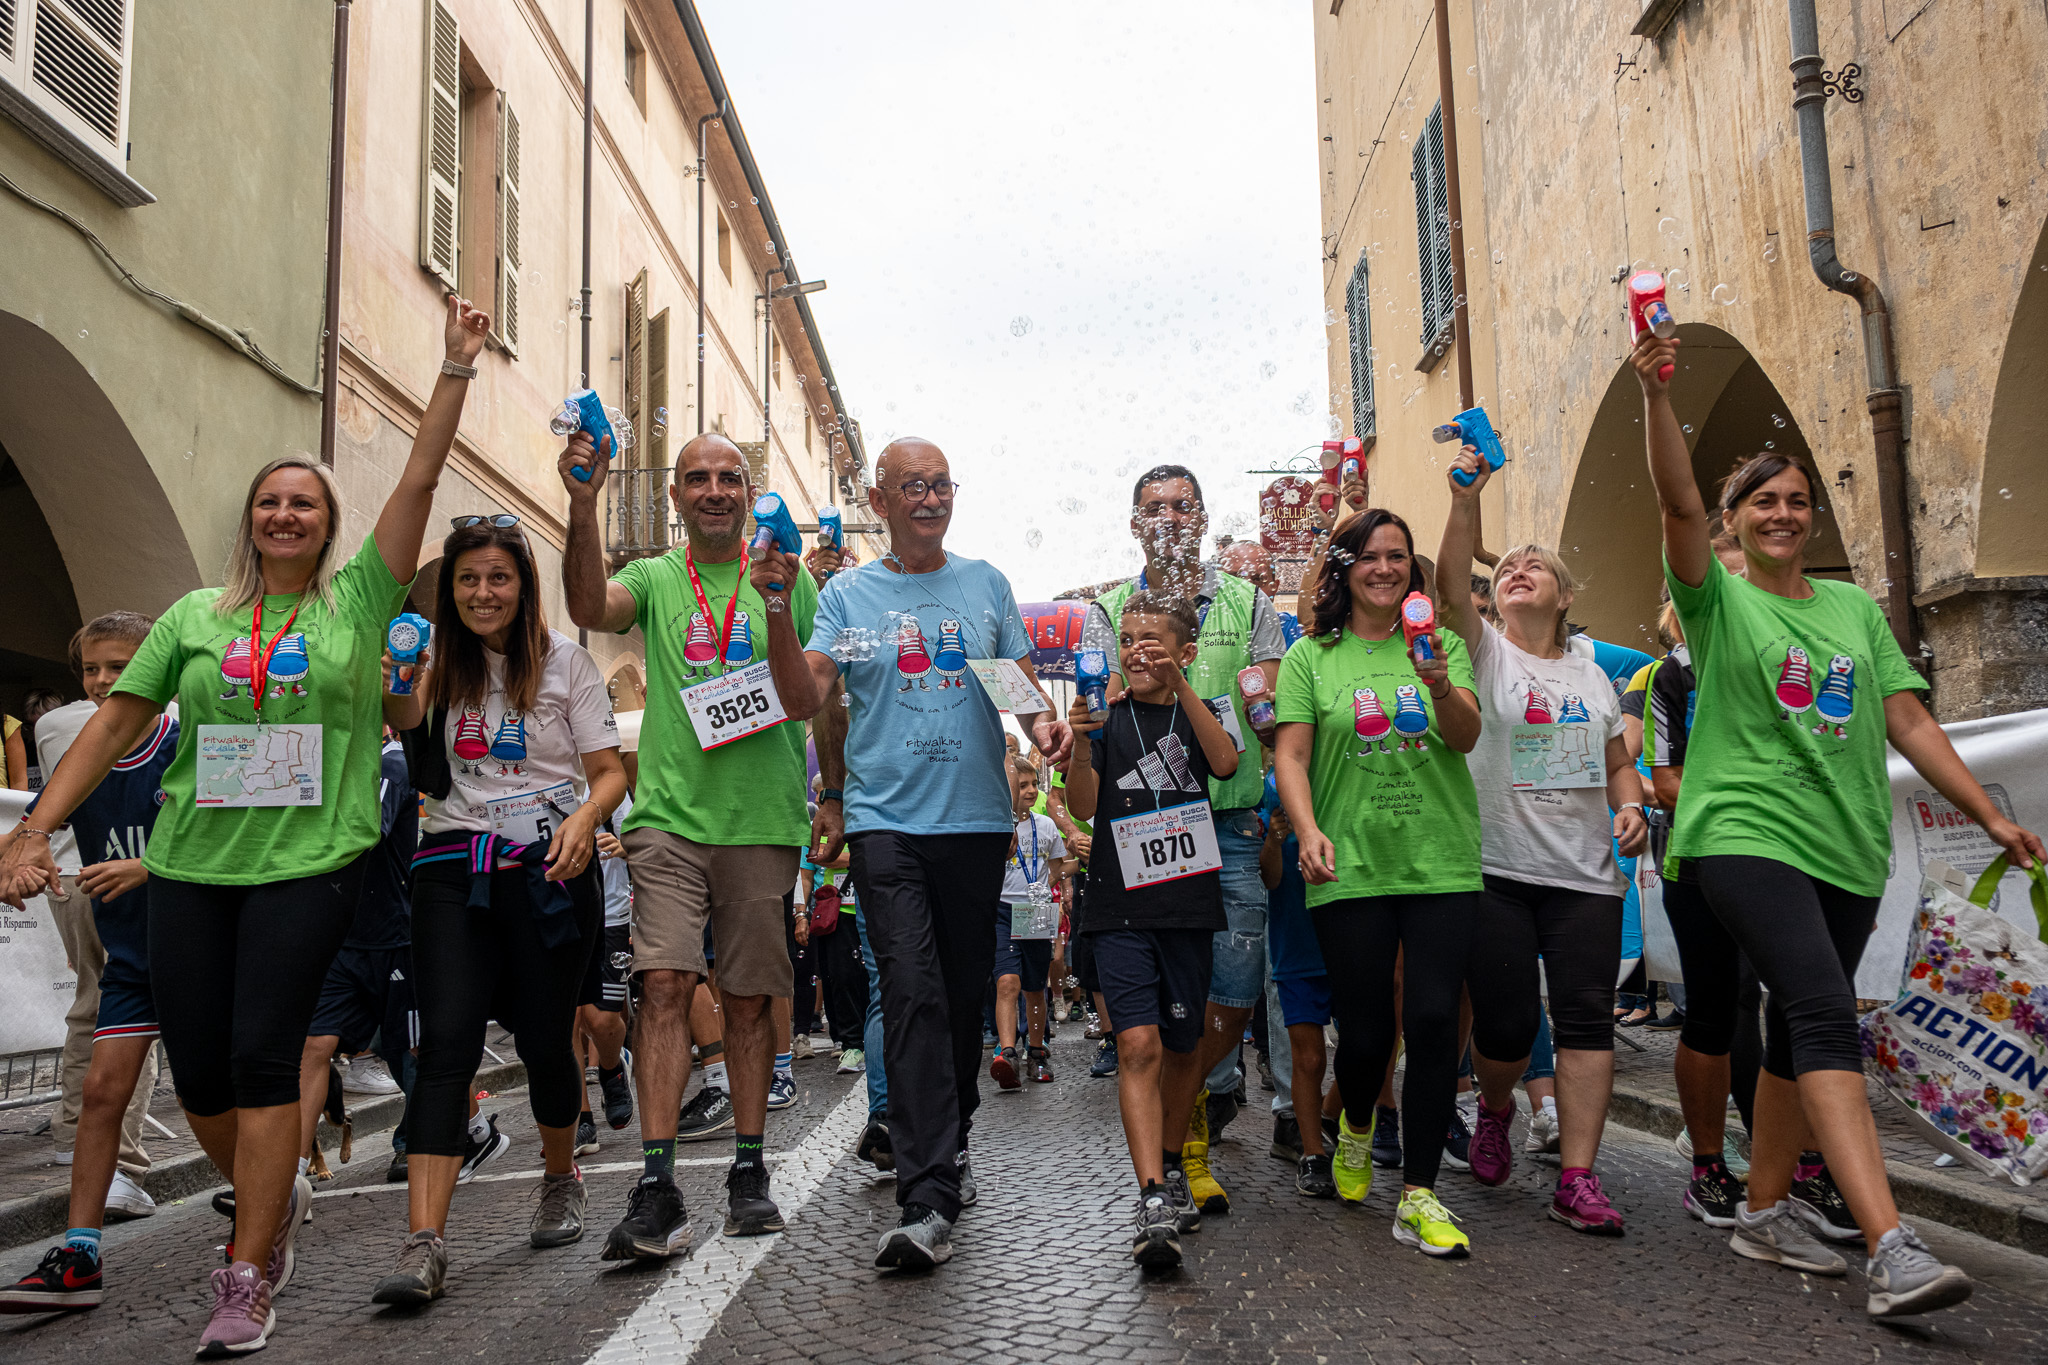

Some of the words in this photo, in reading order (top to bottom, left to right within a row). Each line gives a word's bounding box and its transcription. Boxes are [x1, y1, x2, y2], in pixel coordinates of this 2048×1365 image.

[743, 664, 769, 678] BUSCA
[700, 676, 744, 694] Fitwalking
[703, 688, 732, 701] solidale
[705, 687, 770, 730] 3525
[203, 735, 255, 747] Fitwalking
[905, 735, 962, 750] Fitwalking
[1515, 732, 1552, 741] Fitwalking
[912, 746, 948, 756] solidale
[1376, 780, 1416, 790] Comitato
[553, 788, 573, 798] BUSCA
[1370, 790, 1423, 803] Fitwalking
[510, 806, 541, 817] solidale
[1180, 806, 1207, 817] BUSCA
[1376, 801, 1411, 811] solidale
[1133, 814, 1179, 829] Fitwalking
[536, 816, 553, 843] 5
[1134, 825, 1165, 837] solidale
[1164, 825, 1189, 836] MANU
[1944, 830, 1975, 842] BUSCAFER
[1139, 832, 1197, 869] 1870
[3, 916, 38, 931] Risparmio
[52, 981, 77, 990] COMITATO
[1895, 995, 2048, 1092] ACTION
[1911, 1037, 1982, 1081] action.com
[703, 1095, 730, 1120] HOKA
[736, 1161, 754, 1170] HOKA
[641, 1176, 658, 1185] HOKA
